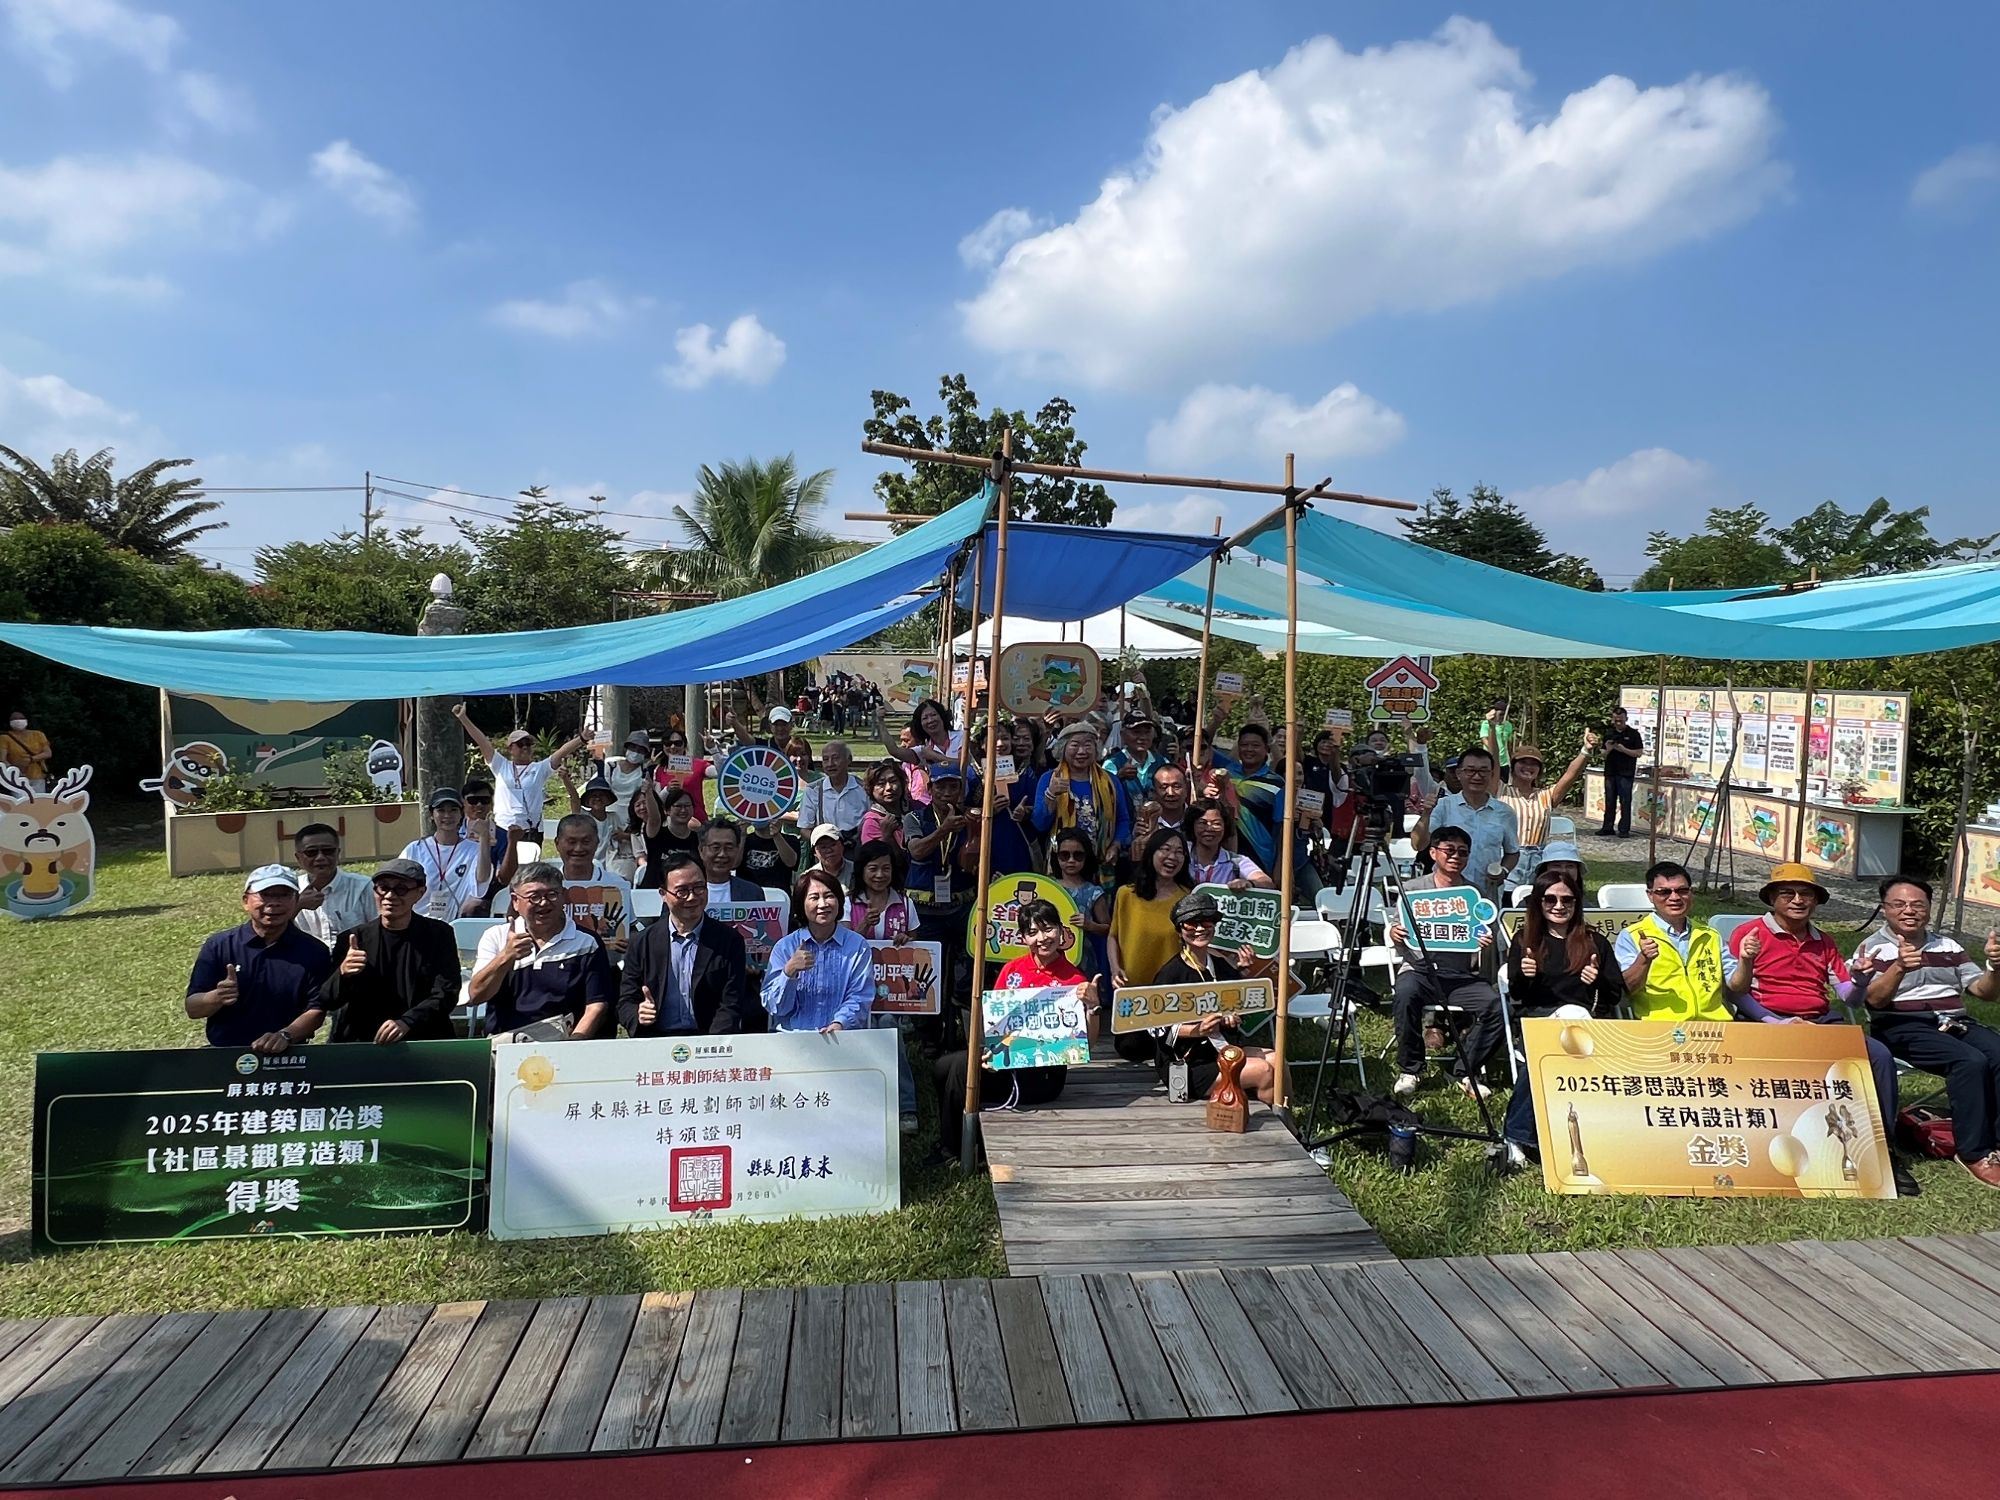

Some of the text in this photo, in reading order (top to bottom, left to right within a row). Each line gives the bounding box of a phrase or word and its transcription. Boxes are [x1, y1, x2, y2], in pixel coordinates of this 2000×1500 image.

[743, 773, 776, 789] SDGs
[706, 907, 781, 921] CEDAW
[1220, 898, 1274, 918] 地創新
[1414, 898, 1467, 916] 越在地
[1218, 920, 1271, 945] 碳永續
[1416, 923, 1469, 941] 越國際
[873, 963, 915, 983] 別平等
[990, 998, 1056, 1016] 希望城市
[1118, 986, 1266, 1018] #2025成果展
[1007, 1011, 1079, 1031] 性別平等
[1669, 1052, 1733, 1064] 屏東好實力
[635, 1067, 773, 1087] 社區規劃師結業證書
[226, 1081, 311, 1097] 屏東好實力
[1556, 1074, 1853, 1101] 2025年謬思設計獎、法國設計獎
[564, 1091, 832, 1121] 屏東縣社區規劃師訓練合格
[145, 1104, 384, 1136] 2025年建築園冶獎
[656, 1123, 743, 1145] 特頒證明
[147, 1138, 380, 1174] 【社區景觀營造類】
[1689, 1135, 1749, 1167] 金獎
[225, 1178, 301, 1214] 得獎
